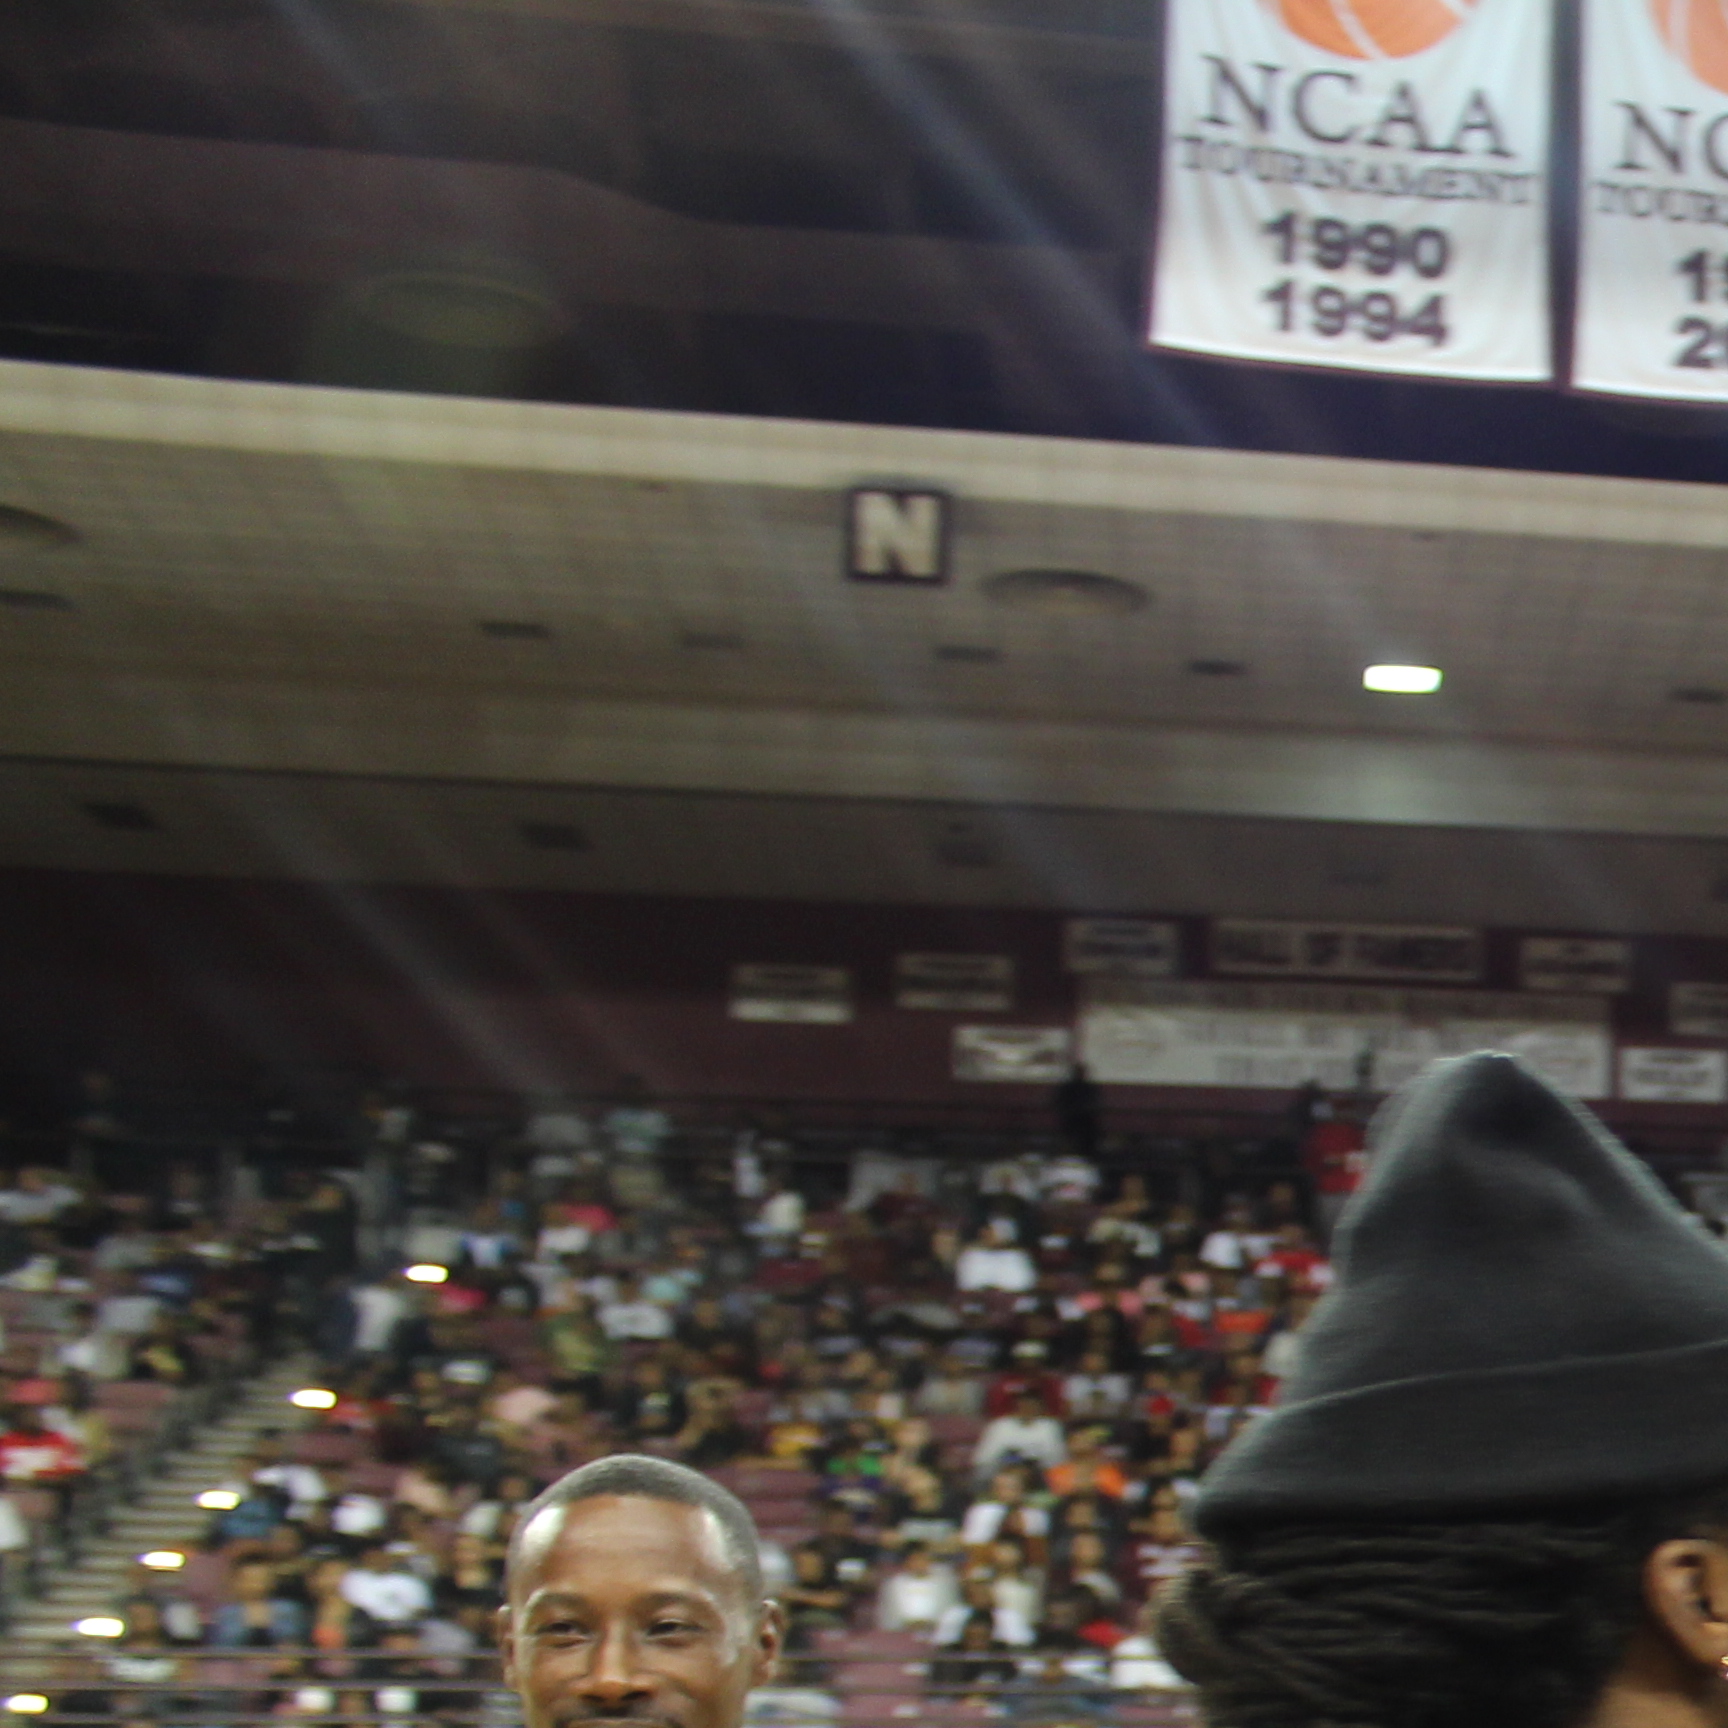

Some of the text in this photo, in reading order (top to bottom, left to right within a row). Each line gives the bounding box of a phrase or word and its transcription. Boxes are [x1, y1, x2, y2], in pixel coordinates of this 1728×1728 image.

[1200, 54, 1517, 158] NCAA
[1175, 134, 1536, 205] TOURNAMENT
[1262, 210, 1452, 280] 1990
[1262, 279, 1451, 349] 1994
[853, 490, 937, 580] N
